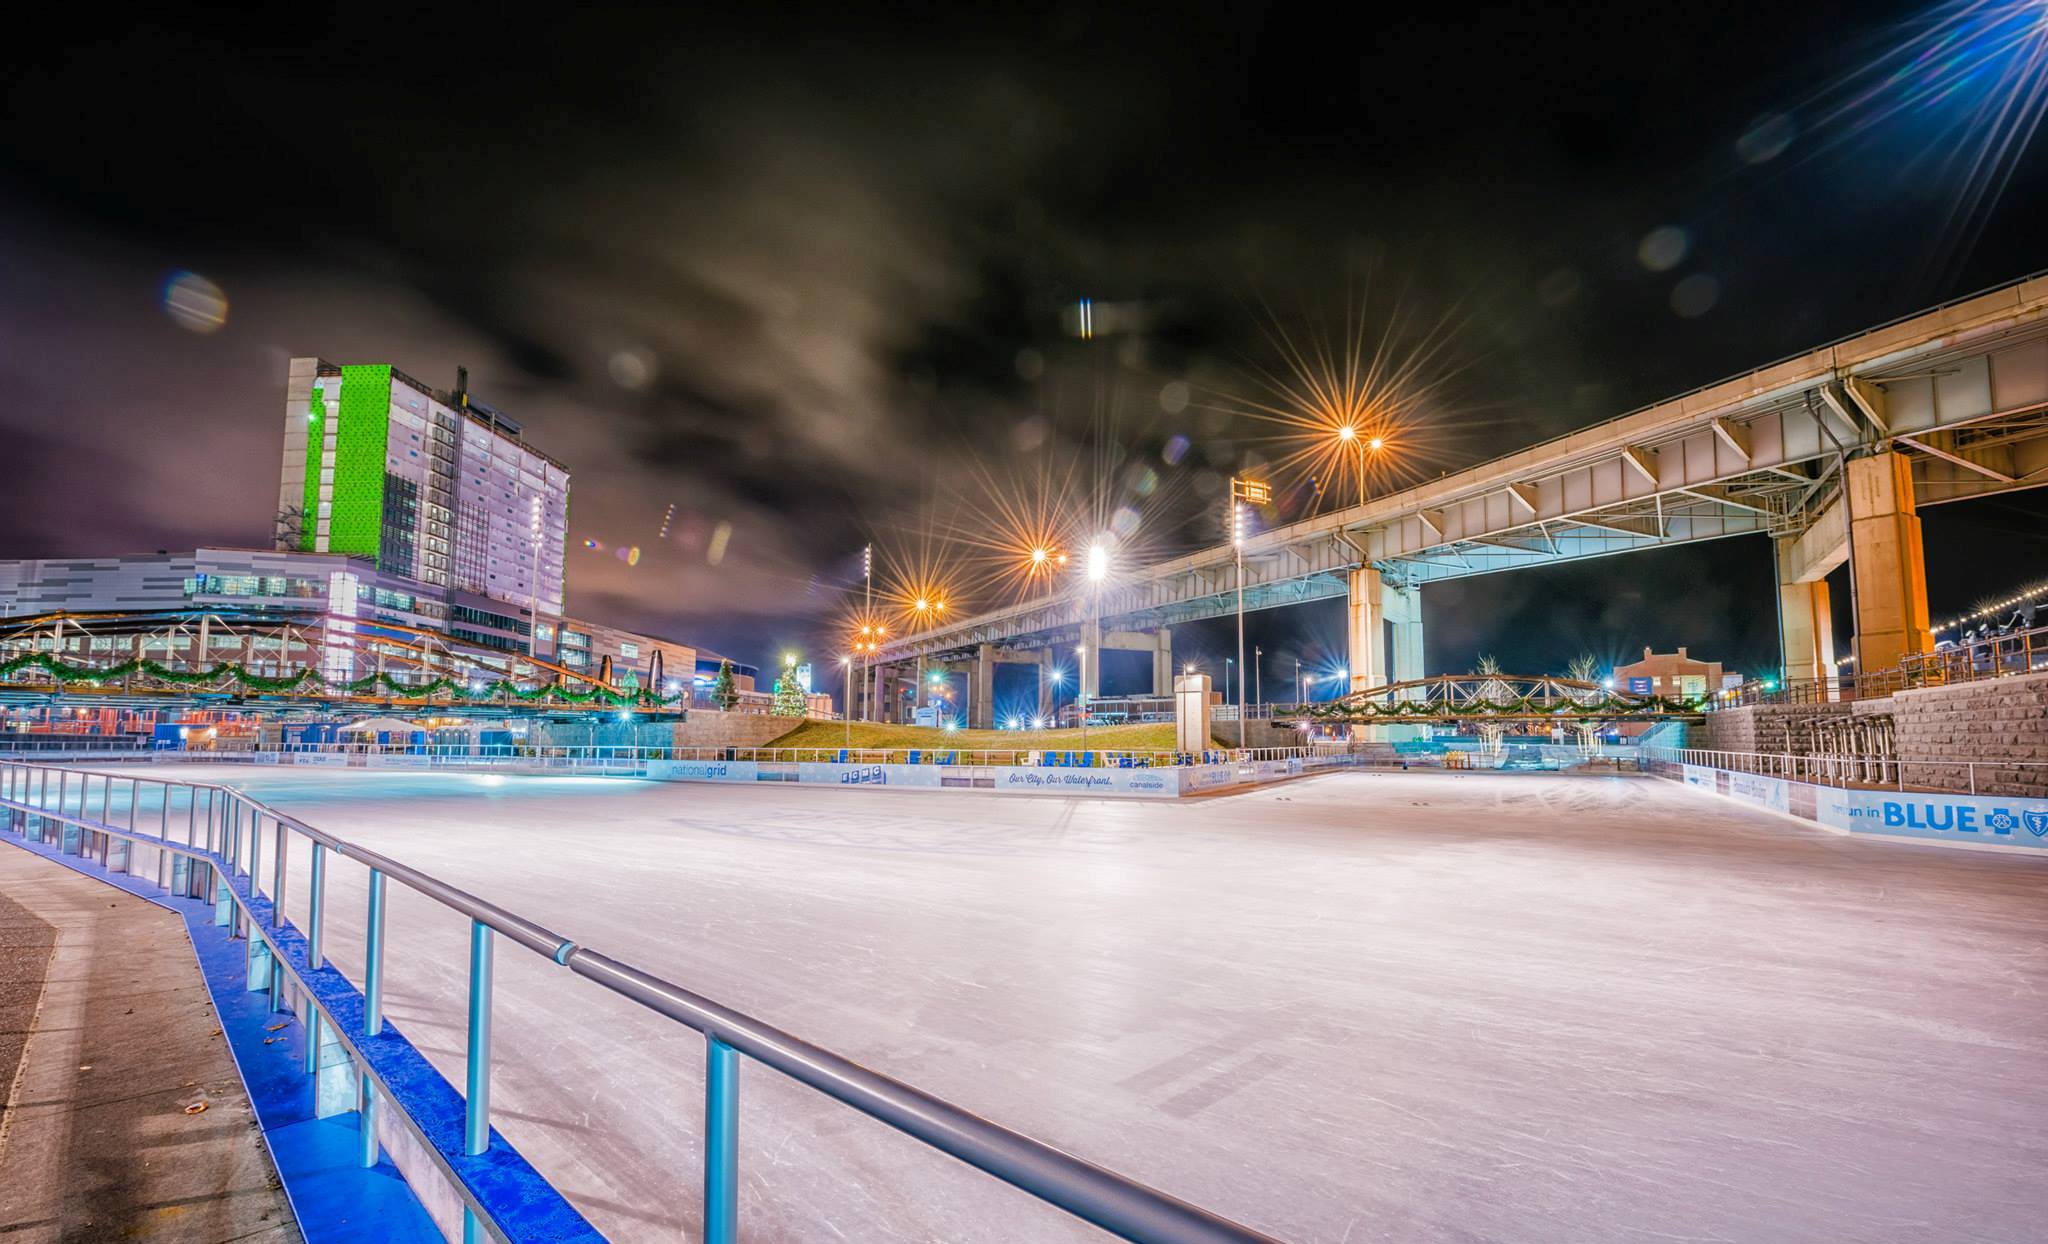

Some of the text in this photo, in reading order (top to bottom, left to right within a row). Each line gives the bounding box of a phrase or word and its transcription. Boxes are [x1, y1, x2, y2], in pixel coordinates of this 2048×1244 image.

[672, 763, 727, 778] nationalgrid
[1009, 773, 1112, 788] Our City, Our Waterfront.
[1129, 781, 1164, 789] canalside
[1866, 806, 1880, 818] in
[1884, 802, 1979, 833] BLUE
